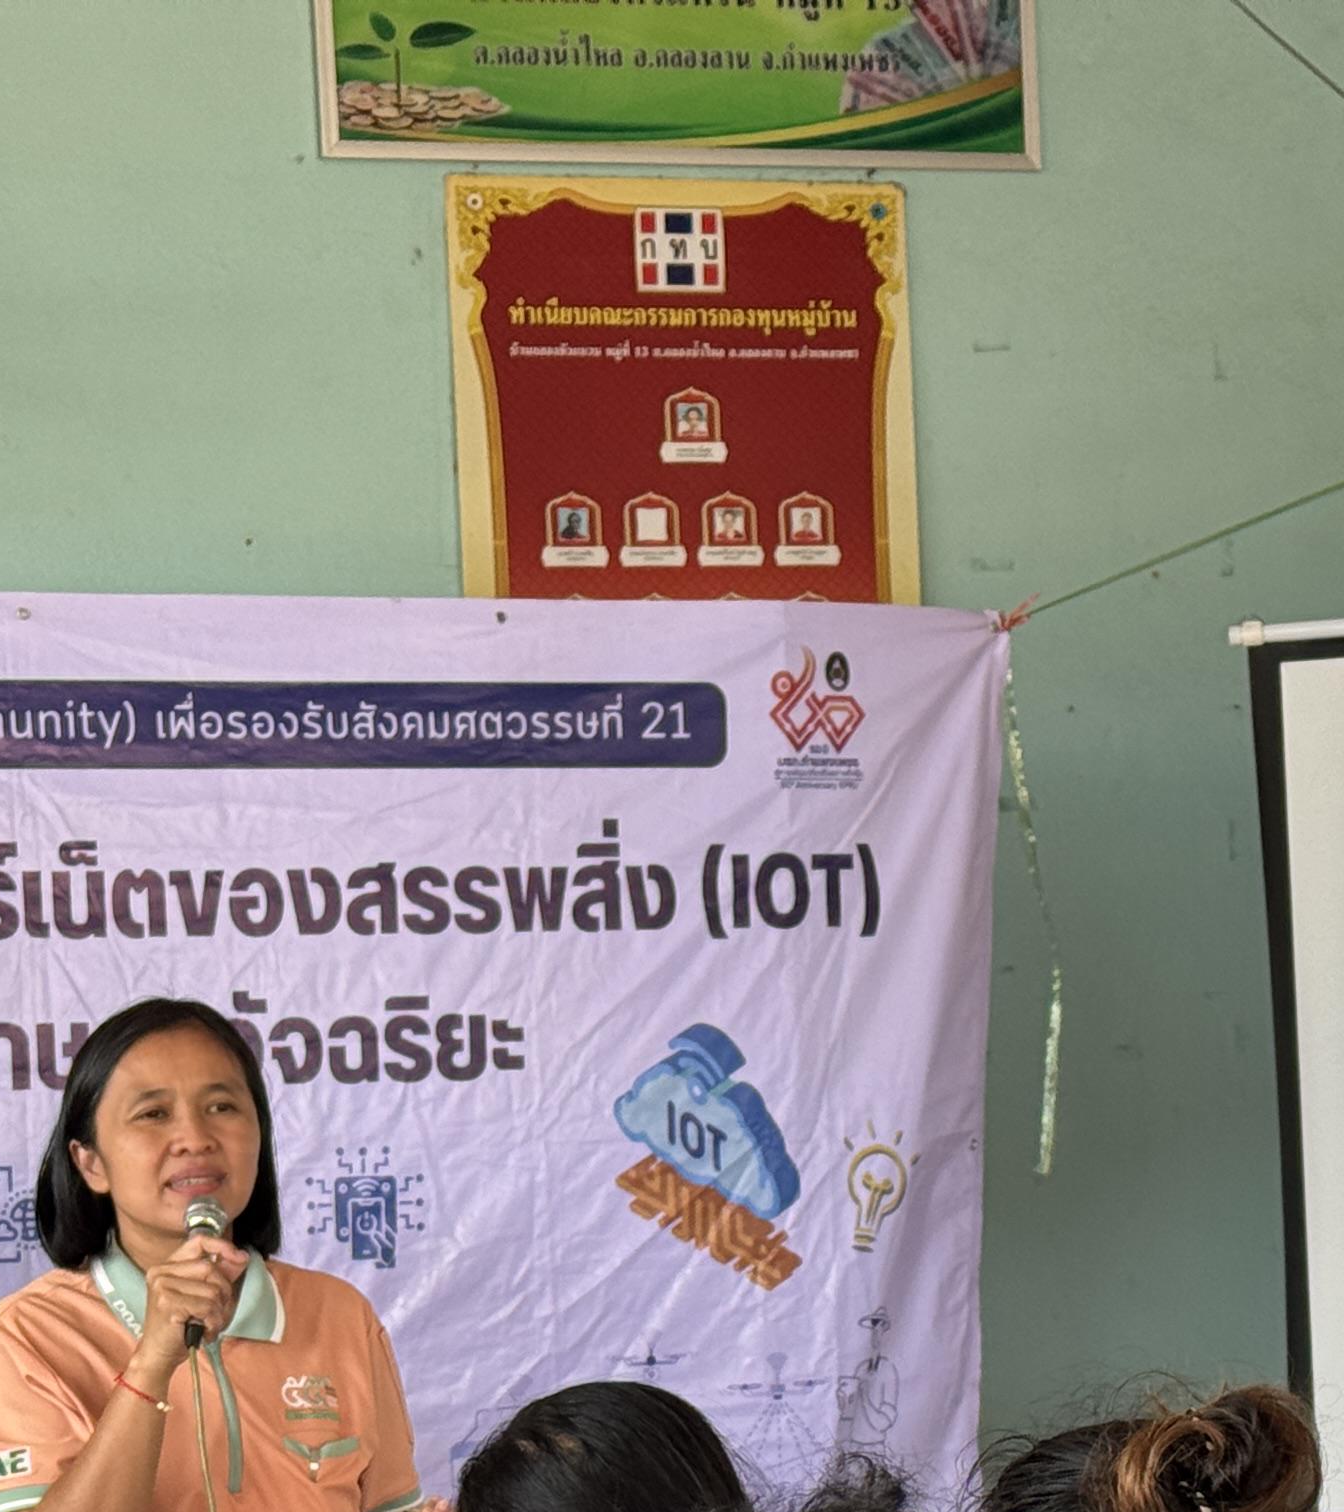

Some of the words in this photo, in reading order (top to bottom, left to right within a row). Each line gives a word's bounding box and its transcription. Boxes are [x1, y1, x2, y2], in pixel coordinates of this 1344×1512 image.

[508, 297, 858, 336] ทำเนียบคณะกรรมการกองทุนหมู่บ้าน
[157, 692, 623, 741] เพื่อรองรับสังคมศตวรรษที่
[642, 702, 692, 740] 21
[702, 842, 881, 939] (IOT)
[665, 1101, 728, 1172] IOT
